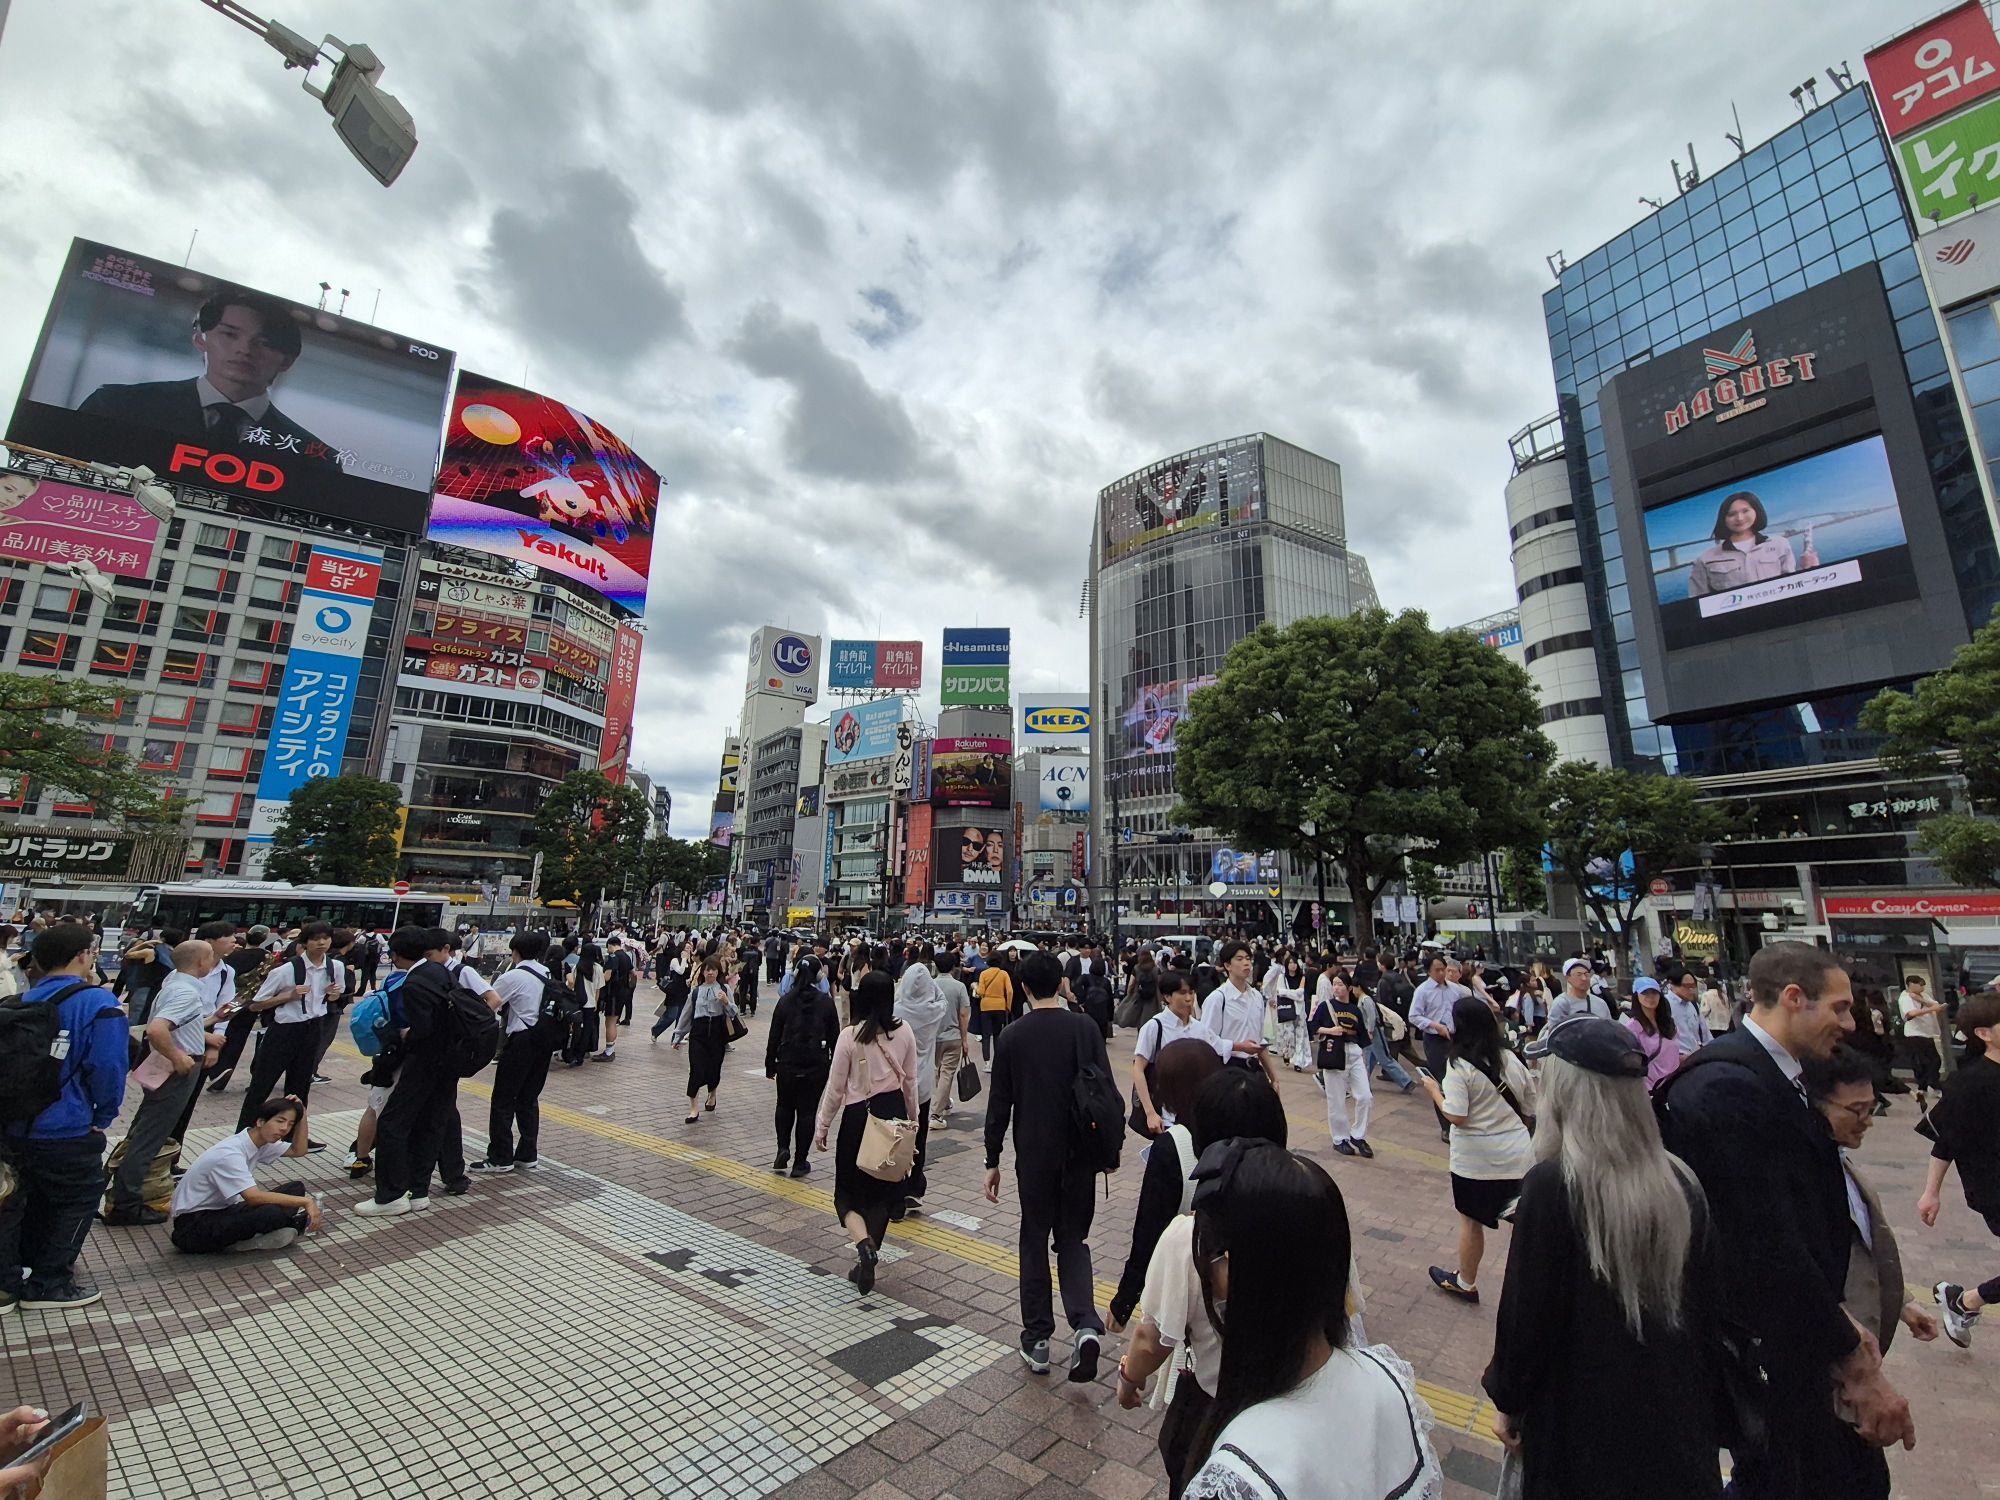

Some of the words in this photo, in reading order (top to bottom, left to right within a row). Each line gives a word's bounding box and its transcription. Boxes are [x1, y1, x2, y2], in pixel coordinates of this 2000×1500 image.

[1892, 56, 1996, 116] アコム
[1913, 139, 2000, 199] レイク
[409, 344, 439, 360] FOD
[1665, 353, 1815, 435] MAGNET
[243, 426, 359, 467] 森次政裕
[169, 443, 285, 492] FOD
[64, 508, 141, 532] クリニック
[2, 531, 141, 569] 品川美容外科
[516, 528, 608, 581] Yakult
[320, 560, 368, 579] 当ビル
[330, 576, 355, 590] 5F
[420, 580, 438, 592] 9F
[474, 587, 527, 610] しゃぶ葉
[437, 617, 523, 643] プライス
[301, 633, 358, 650] eyecity
[944, 641, 1009, 652] Hisamitsu
[490, 650, 531, 667] ガスト
[549, 637, 597, 669] コンタクト
[404, 656, 427, 670] 7F
[431, 660, 456, 671] Café
[457, 663, 512, 686] ガスト
[583, 676, 605, 693] ガスト
[796, 685, 813, 695] VISA
[944, 677, 1006, 693] サロンパス
[275, 668, 324, 777] アイシティ
[307, 673, 349, 778] コンタクトの
[1031, 714, 1087, 725] IKEA
[954, 740, 988, 748] Rakuten
[893, 722, 912, 787] もんじゃ
[1042, 766, 1090, 782] ACN
[1848, 796, 1940, 818] 星乃珈琲
[0, 836, 116, 861] ンドラッグ
[14, 859, 59, 869] CARER
[938, 892, 998, 906] 大盛堂店
[1915, 899, 1970, 913] Corner
